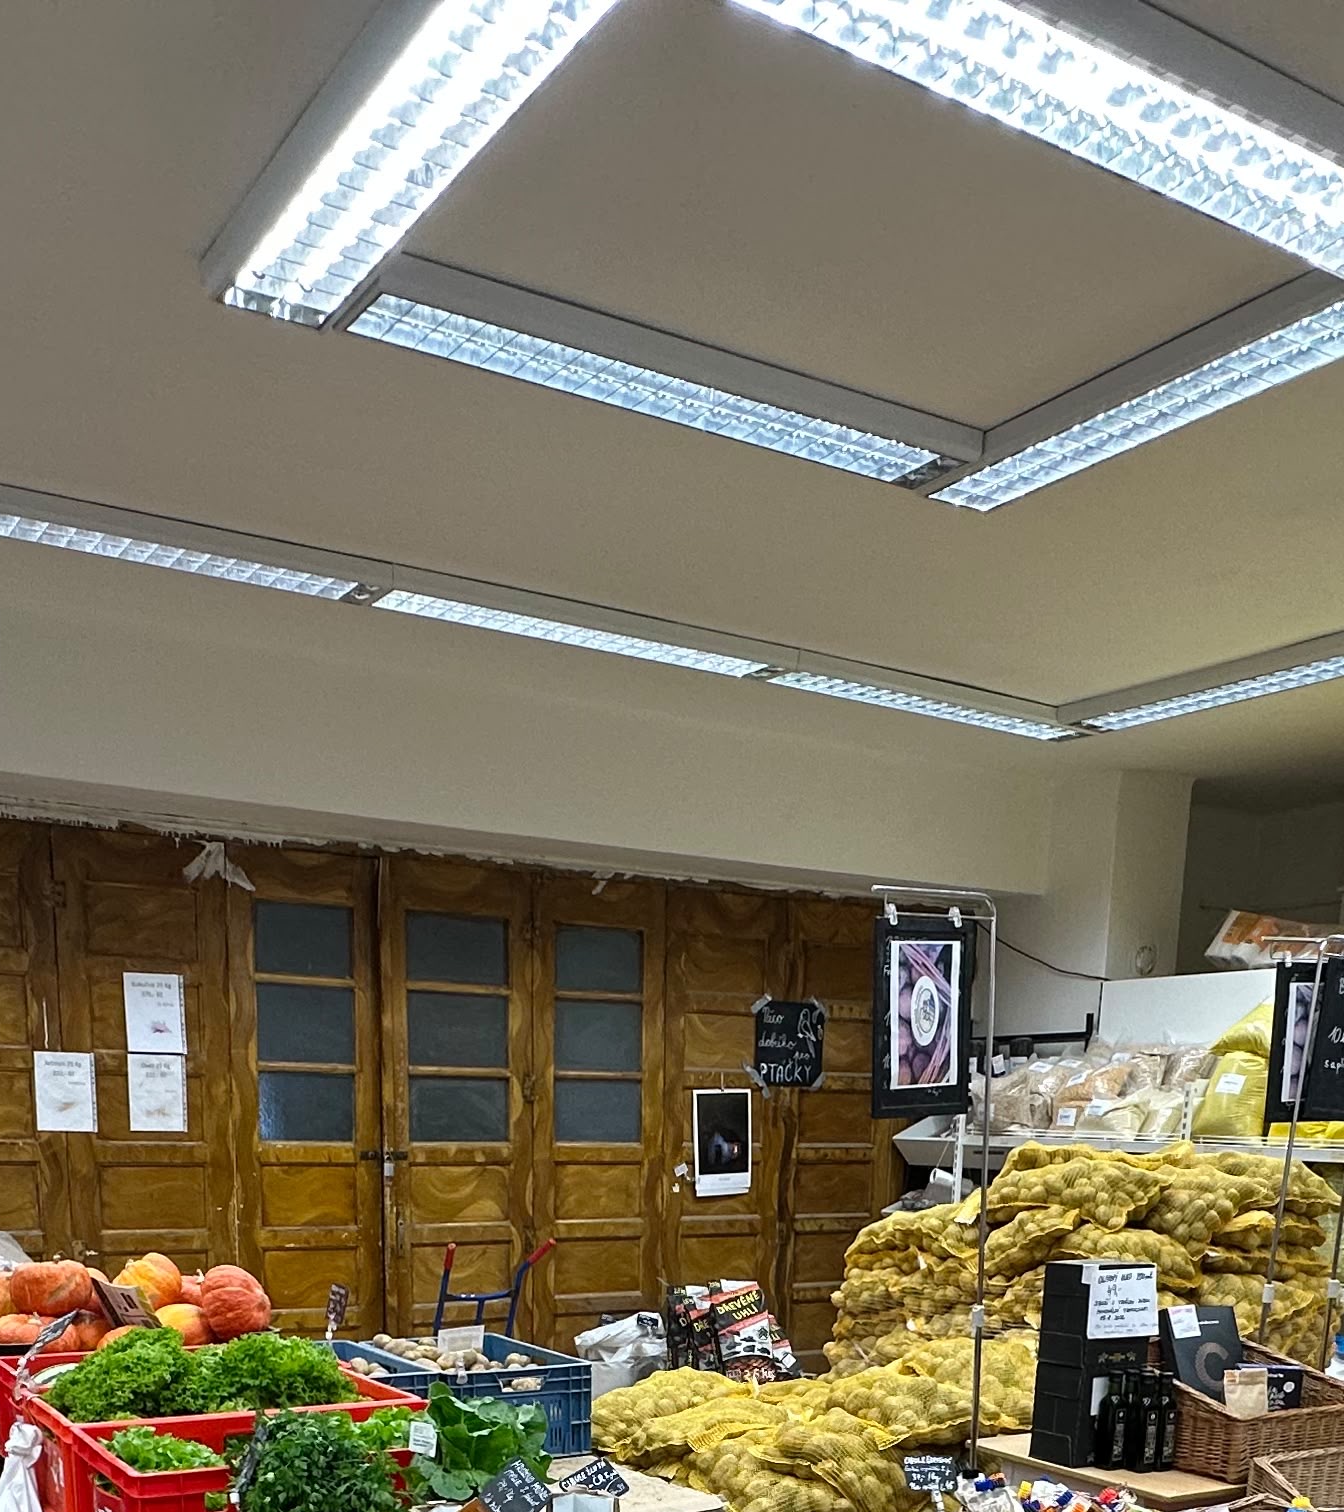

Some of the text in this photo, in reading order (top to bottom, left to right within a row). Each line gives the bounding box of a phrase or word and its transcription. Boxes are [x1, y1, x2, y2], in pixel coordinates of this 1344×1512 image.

[759, 1058, 812, 1083] PTÁČKY
[716, 1289, 761, 1316] DŘEVĚNÉ
[732, 1307, 759, 1322] UHLÍ
